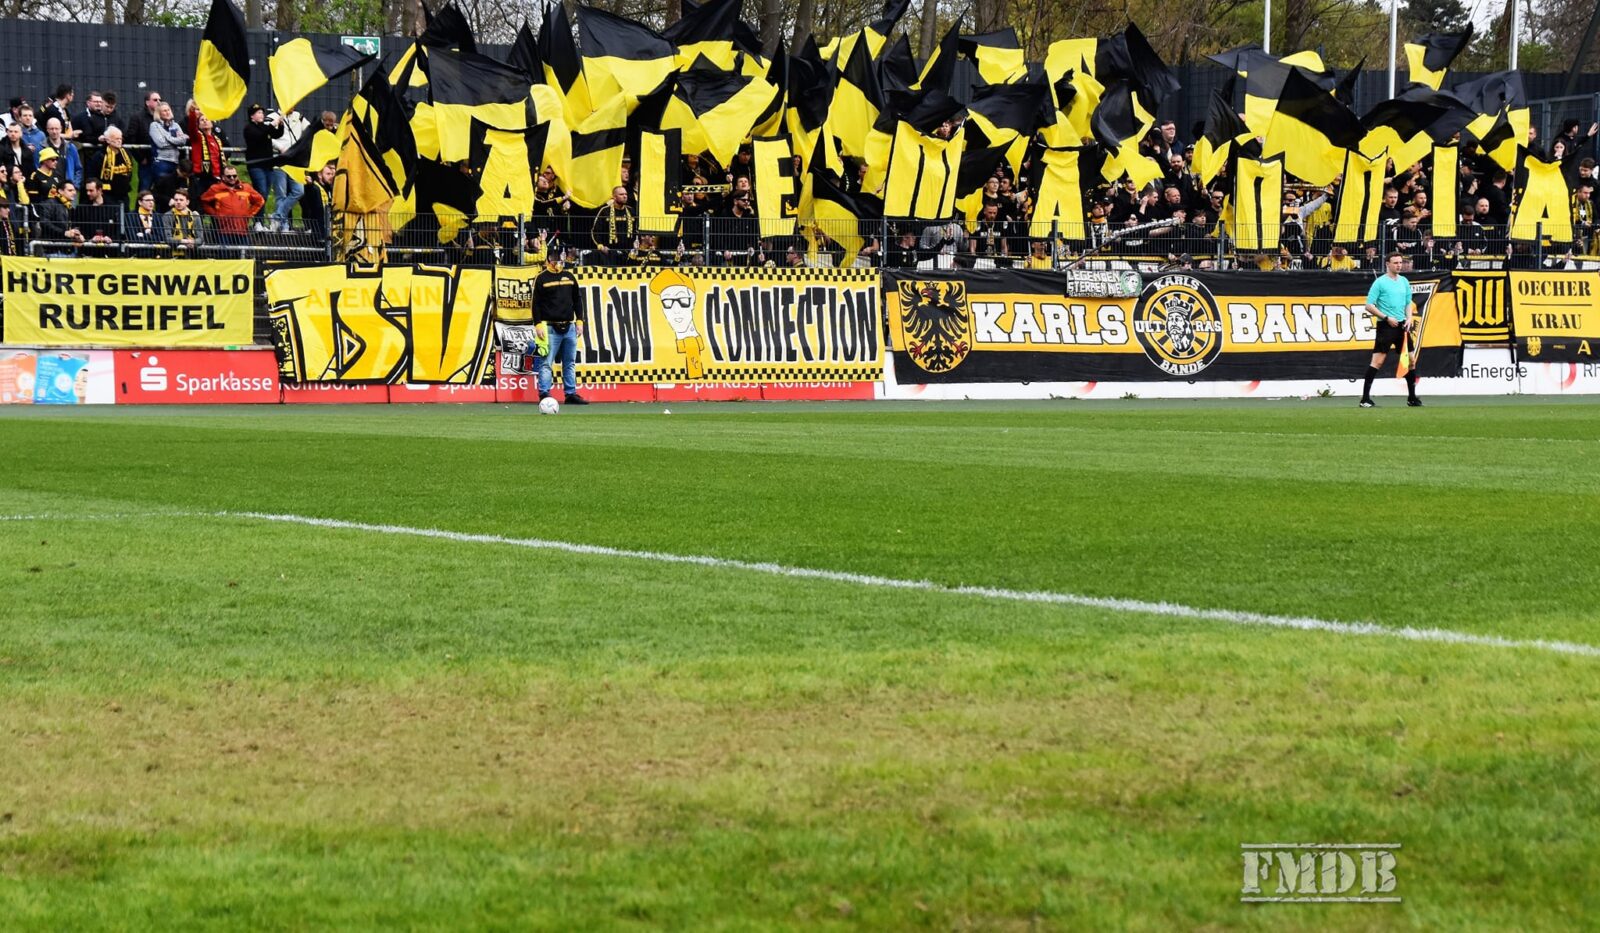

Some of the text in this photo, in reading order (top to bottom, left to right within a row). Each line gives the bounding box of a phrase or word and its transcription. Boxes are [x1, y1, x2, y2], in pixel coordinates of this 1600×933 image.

[7, 268, 250, 296] HÜRTGENWALD
[1153, 275, 1200, 291] KARLS
[1518, 279, 1592, 297] OECHER
[498, 300, 531, 308] ERHALTE
[38, 303, 226, 331] RUREIFEL
[265, 265, 493, 381] TSV
[706, 286, 877, 362] CONNECTION
[970, 301, 1377, 345] KARLS BANDE
[1531, 313, 1582, 330] KRAU
[1134, 320, 1222, 333] ULT RAS
[503, 353, 520, 369] ZU
[1160, 359, 1206, 375] BANDE
[176, 373, 272, 395] Sparkasse
